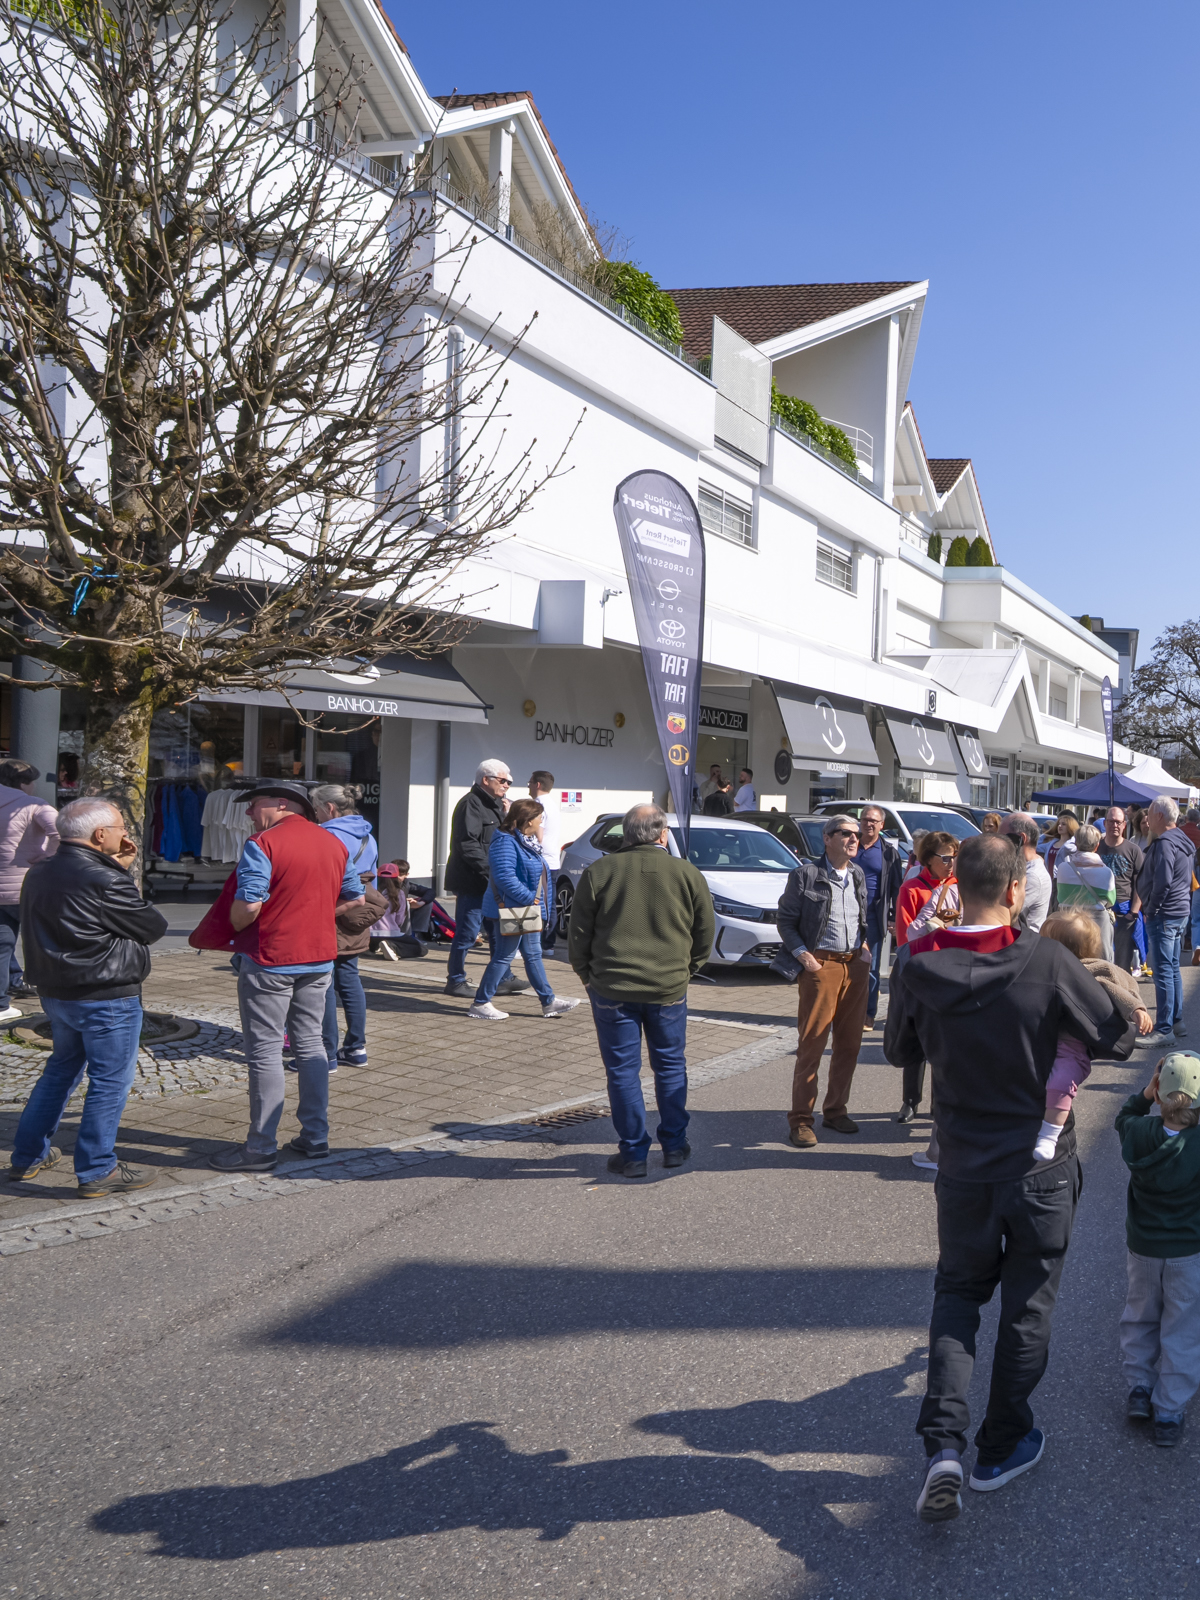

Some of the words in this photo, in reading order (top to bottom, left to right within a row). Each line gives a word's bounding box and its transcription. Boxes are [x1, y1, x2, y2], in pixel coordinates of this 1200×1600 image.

[327, 695, 399, 715] BANHOLZER
[535, 720, 615, 748] BANHOLZER
[826, 761, 850, 772] MODEHAUS
